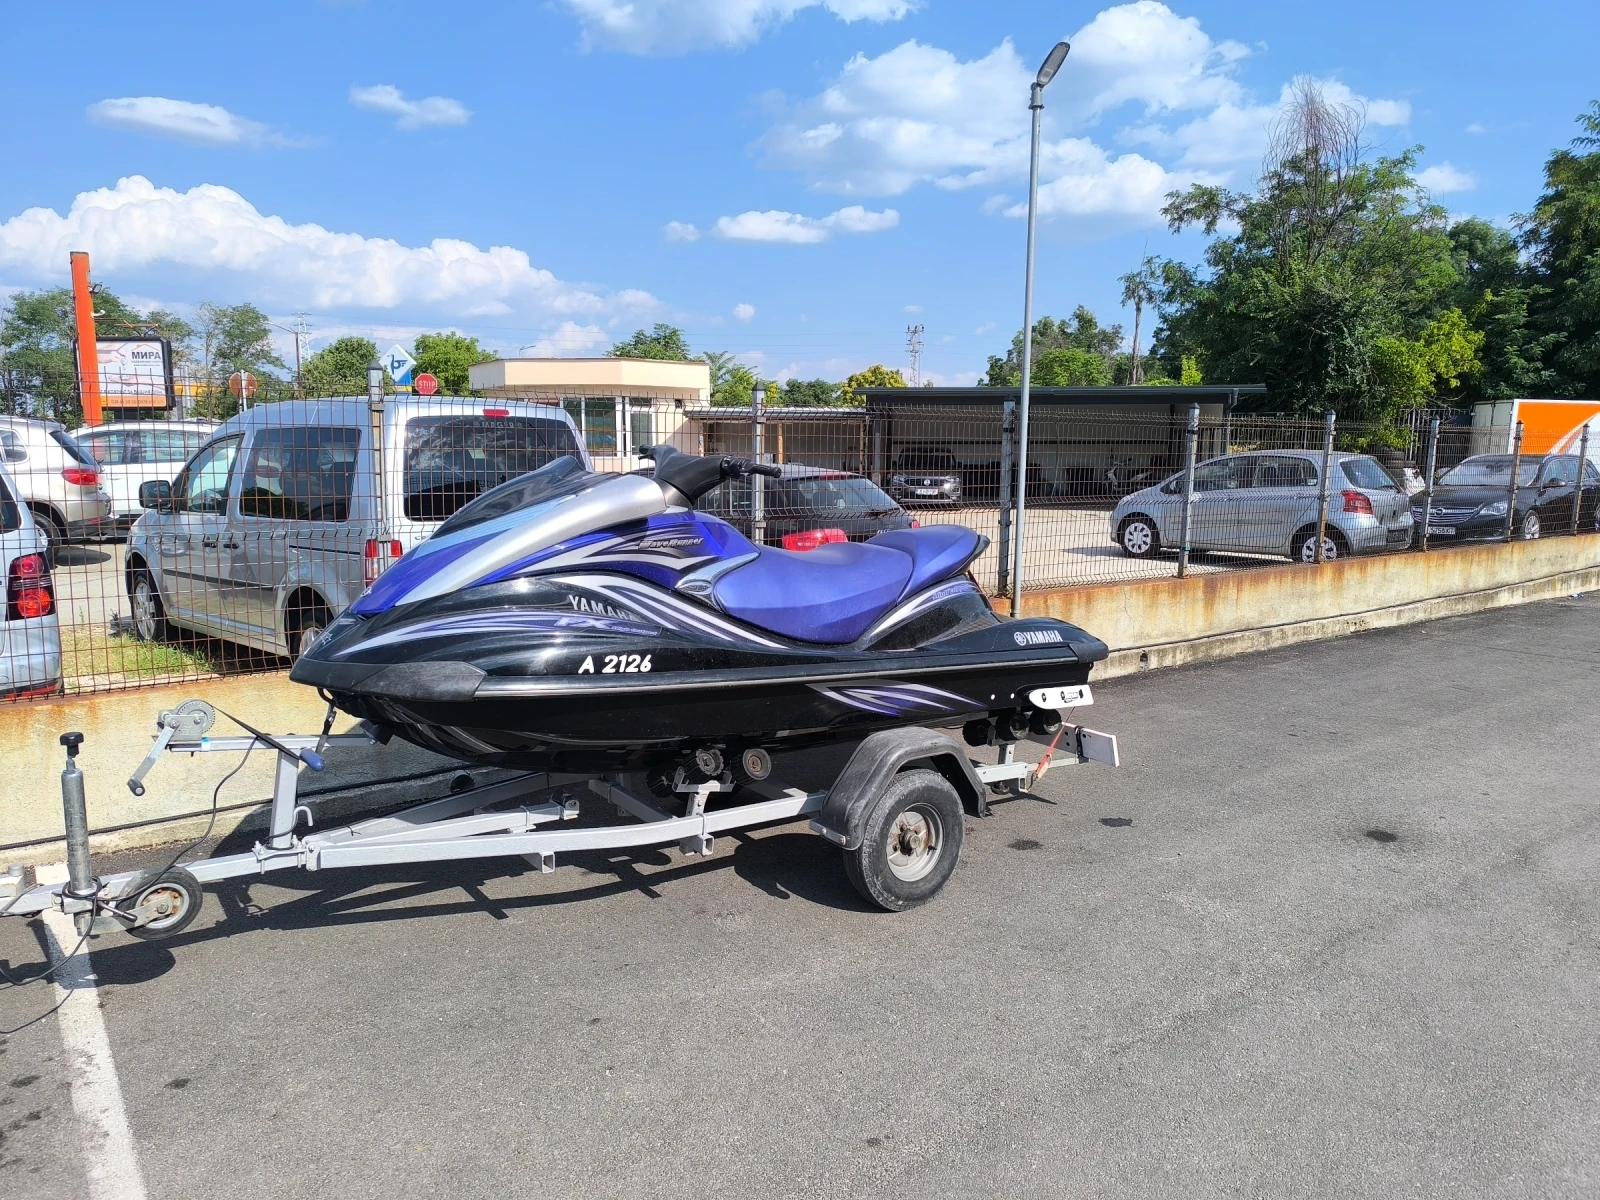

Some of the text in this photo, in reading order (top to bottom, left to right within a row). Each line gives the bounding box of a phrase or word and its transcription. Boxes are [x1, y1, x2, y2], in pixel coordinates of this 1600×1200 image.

[131, 351, 161, 360] МИРА
[418, 380, 436, 390] STOP
[638, 538, 704, 550] WaveRunner
[569, 595, 642, 622] YAMAHA
[1024, 630, 1063, 644] YAMAHA
[577, 654, 652, 674] A 2126
